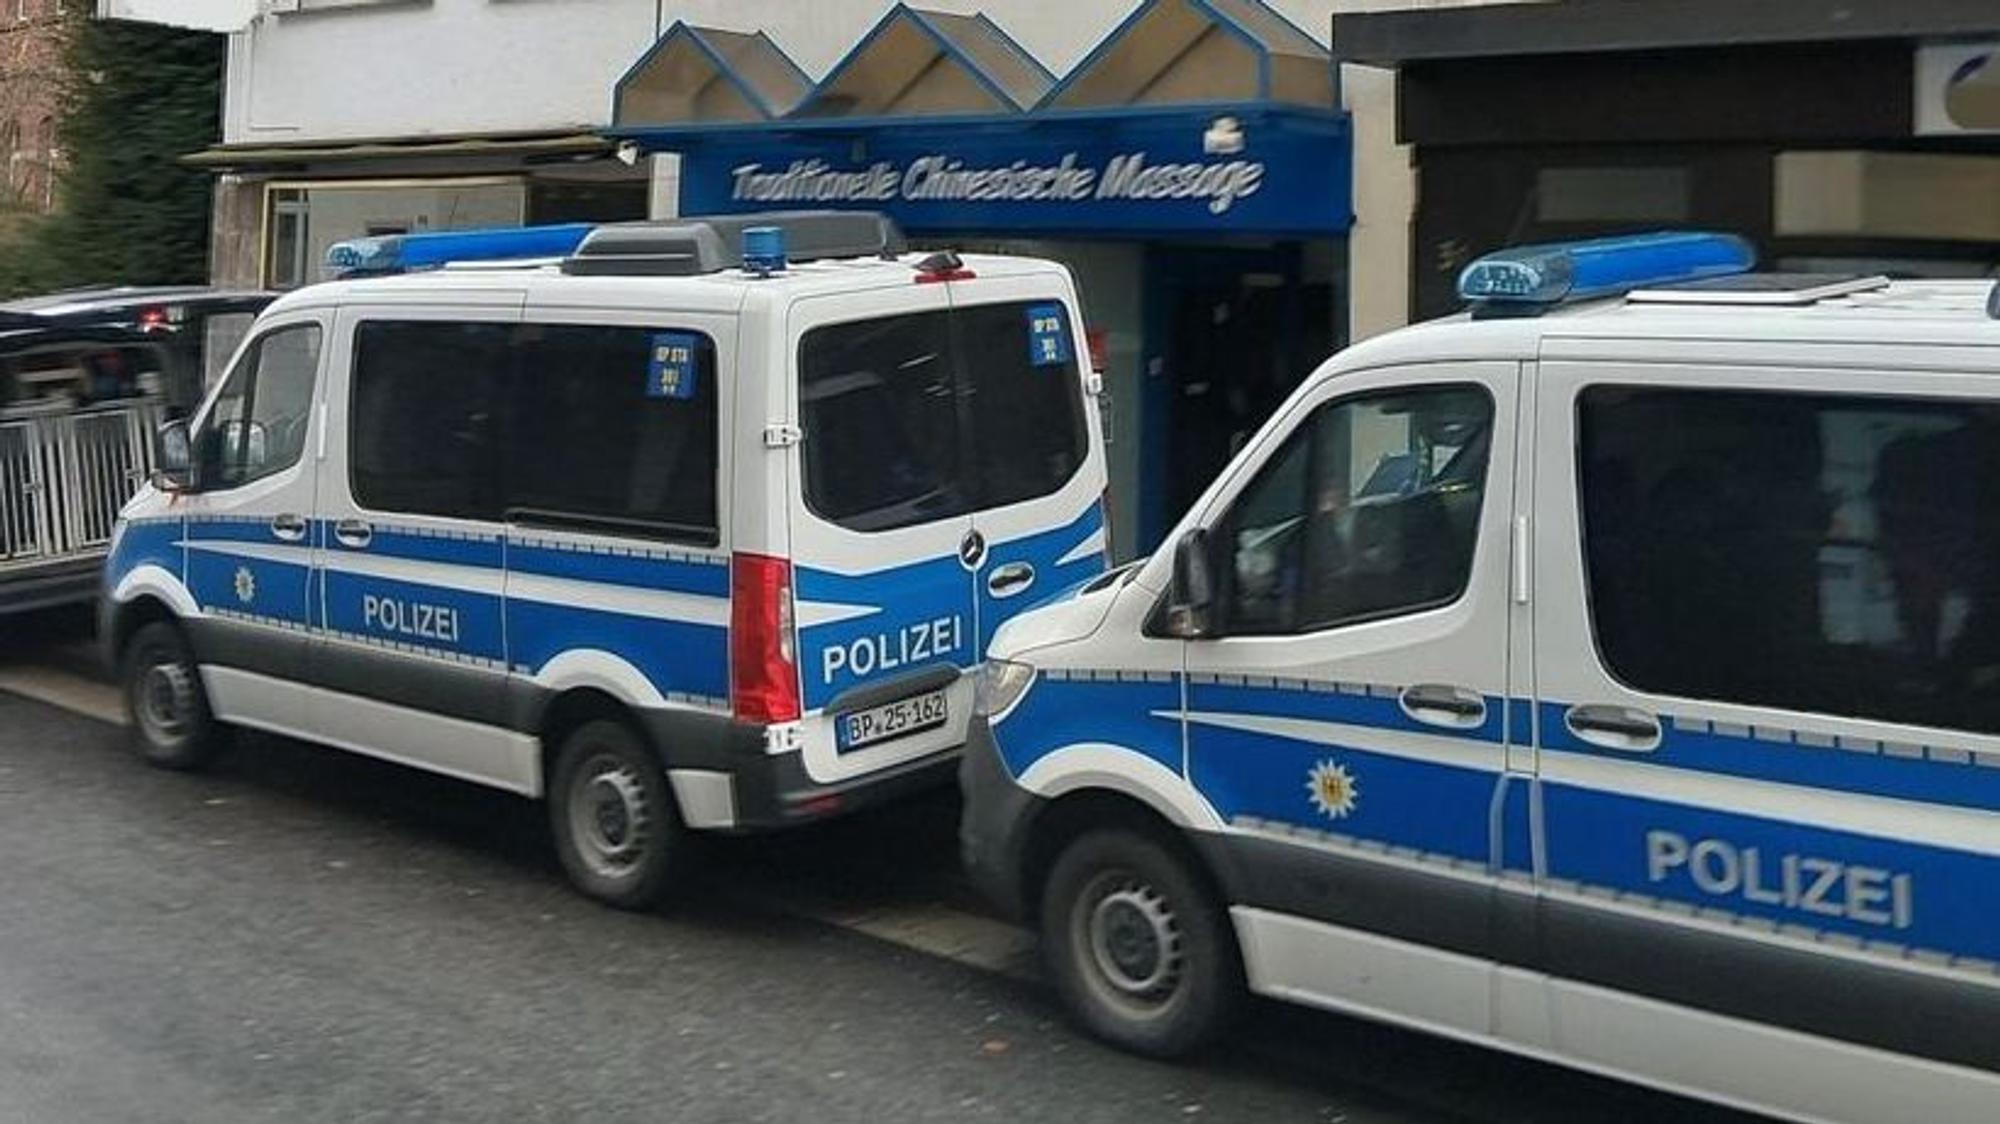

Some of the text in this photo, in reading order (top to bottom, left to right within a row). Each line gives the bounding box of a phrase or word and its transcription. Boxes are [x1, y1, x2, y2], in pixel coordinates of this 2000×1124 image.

[902, 152, 1097, 201] Chinesische
[1098, 150, 1263, 215] Massage
[363, 593, 459, 643] POLIZEI
[823, 614, 962, 684] POLIZEI
[851, 714, 872, 741] BP
[1646, 829, 1913, 929] POLIZEI
